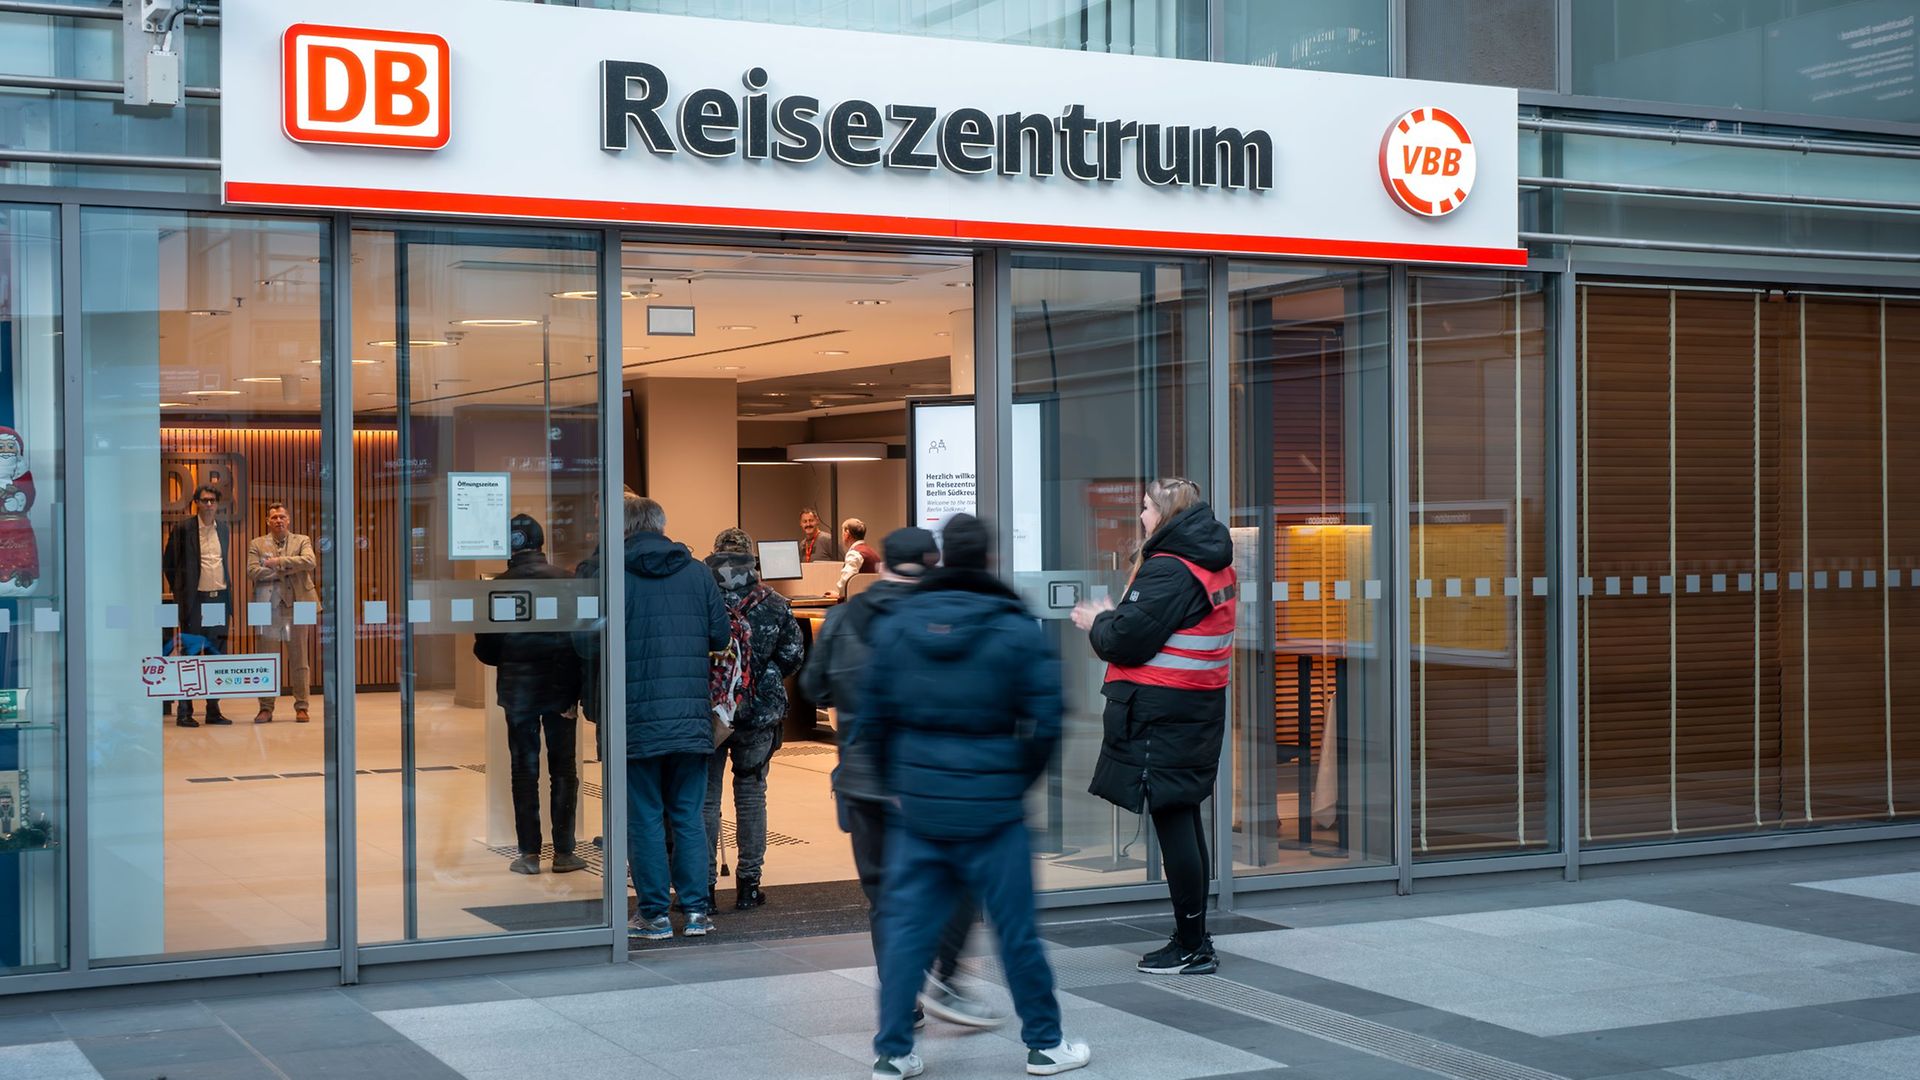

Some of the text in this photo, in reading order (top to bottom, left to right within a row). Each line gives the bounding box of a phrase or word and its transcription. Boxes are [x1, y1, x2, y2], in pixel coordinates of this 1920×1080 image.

[307, 44, 430, 127] DB
[600, 60, 1275, 191] Reisezentrum
[1403, 145, 1462, 177] VBB
[457, 480, 498, 488] Öffnungszeiten
[142, 665, 165, 675] VBB
[255, 666, 270, 674] FÜR:
